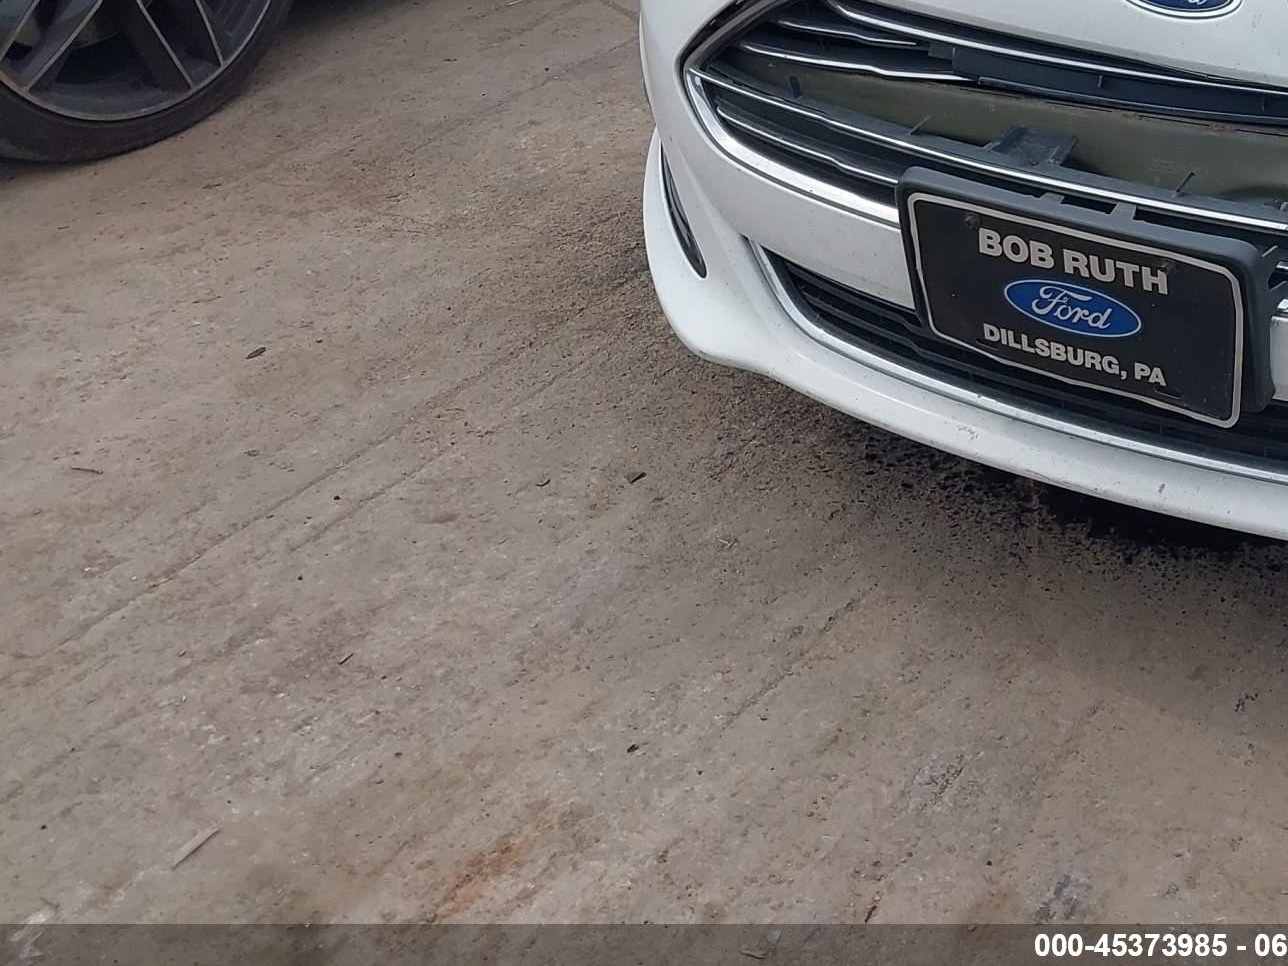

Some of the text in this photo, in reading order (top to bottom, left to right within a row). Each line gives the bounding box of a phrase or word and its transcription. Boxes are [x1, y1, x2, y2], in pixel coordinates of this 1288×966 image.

[978, 227, 1169, 296] BOB RUTH
[1031, 285, 1113, 331] Ford
[982, 322, 1167, 387] DILLSBURG, PA
